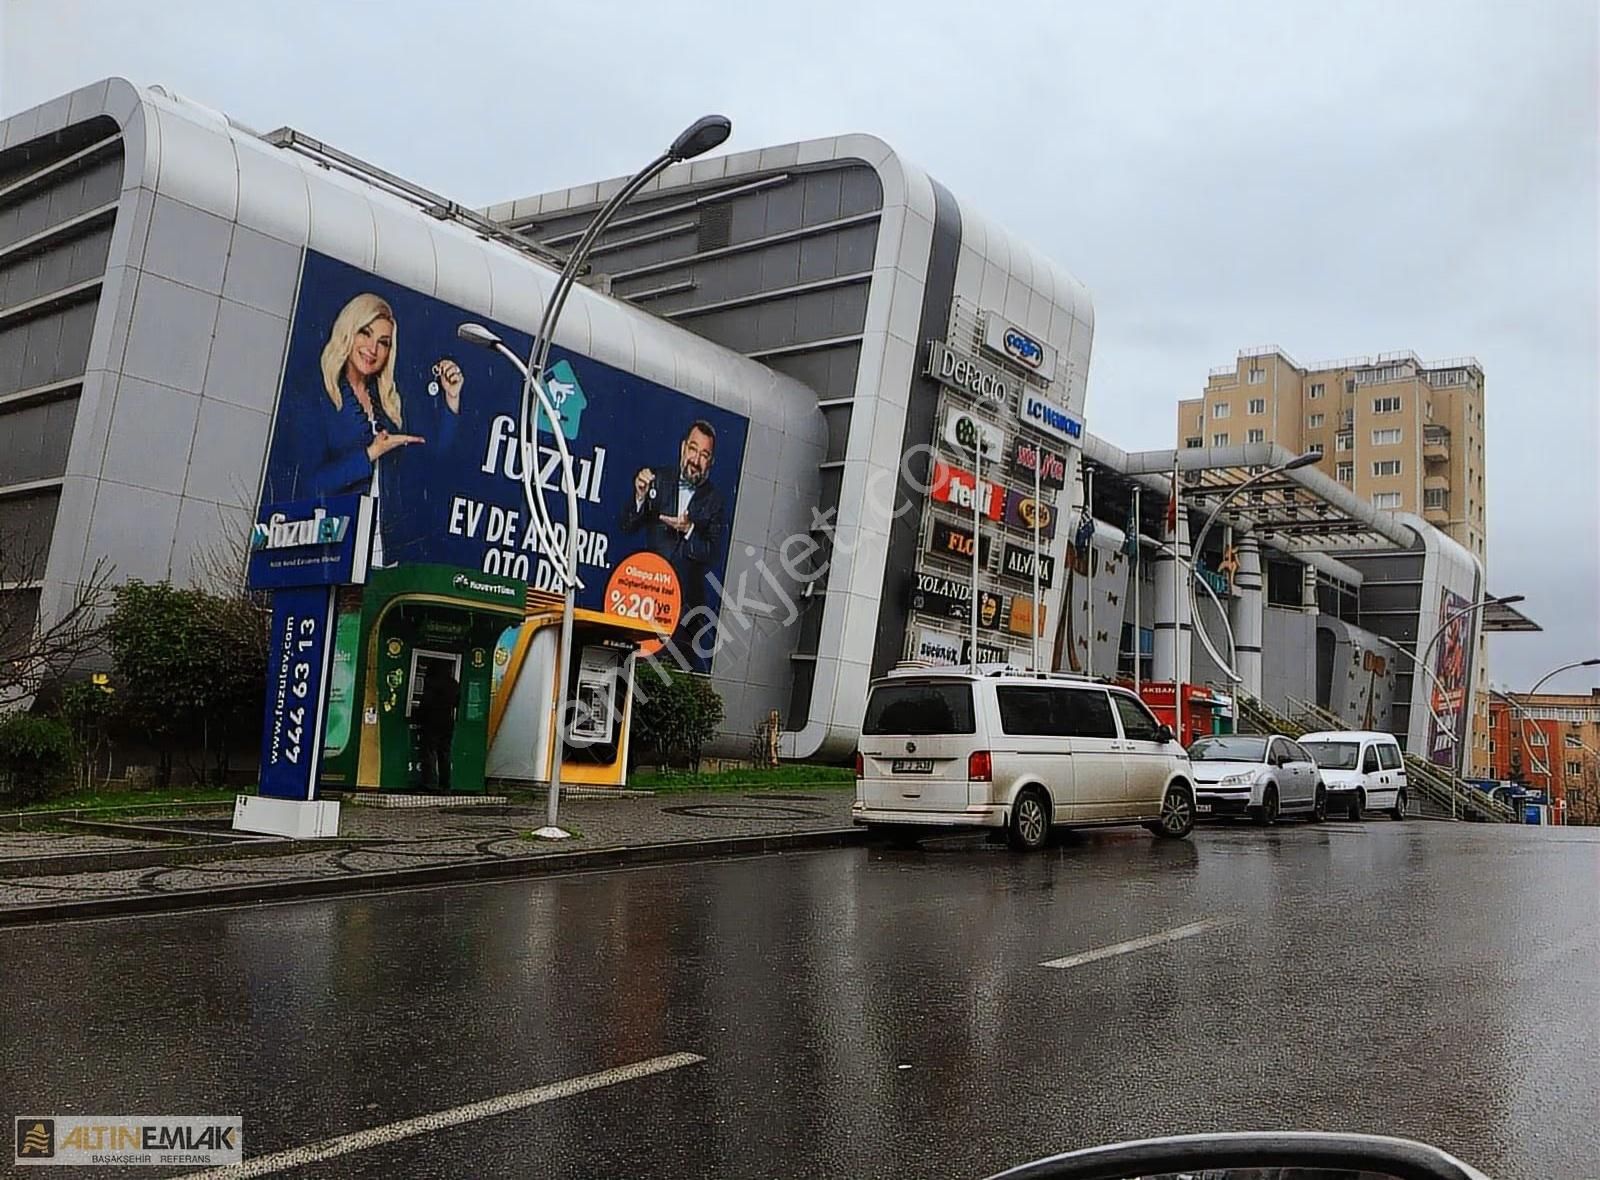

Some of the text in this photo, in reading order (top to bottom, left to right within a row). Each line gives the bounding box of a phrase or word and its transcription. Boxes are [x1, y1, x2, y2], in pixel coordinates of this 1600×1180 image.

[942, 350, 1006, 403] DeFacto
[1027, 398, 1042, 418] LC
[482, 415, 606, 503] fuzul
[449, 497, 611, 568] EV DE ALDRIR.
[967, 647, 1000, 664] CYSTAL
[285, 618, 315, 763] 444 63 13
